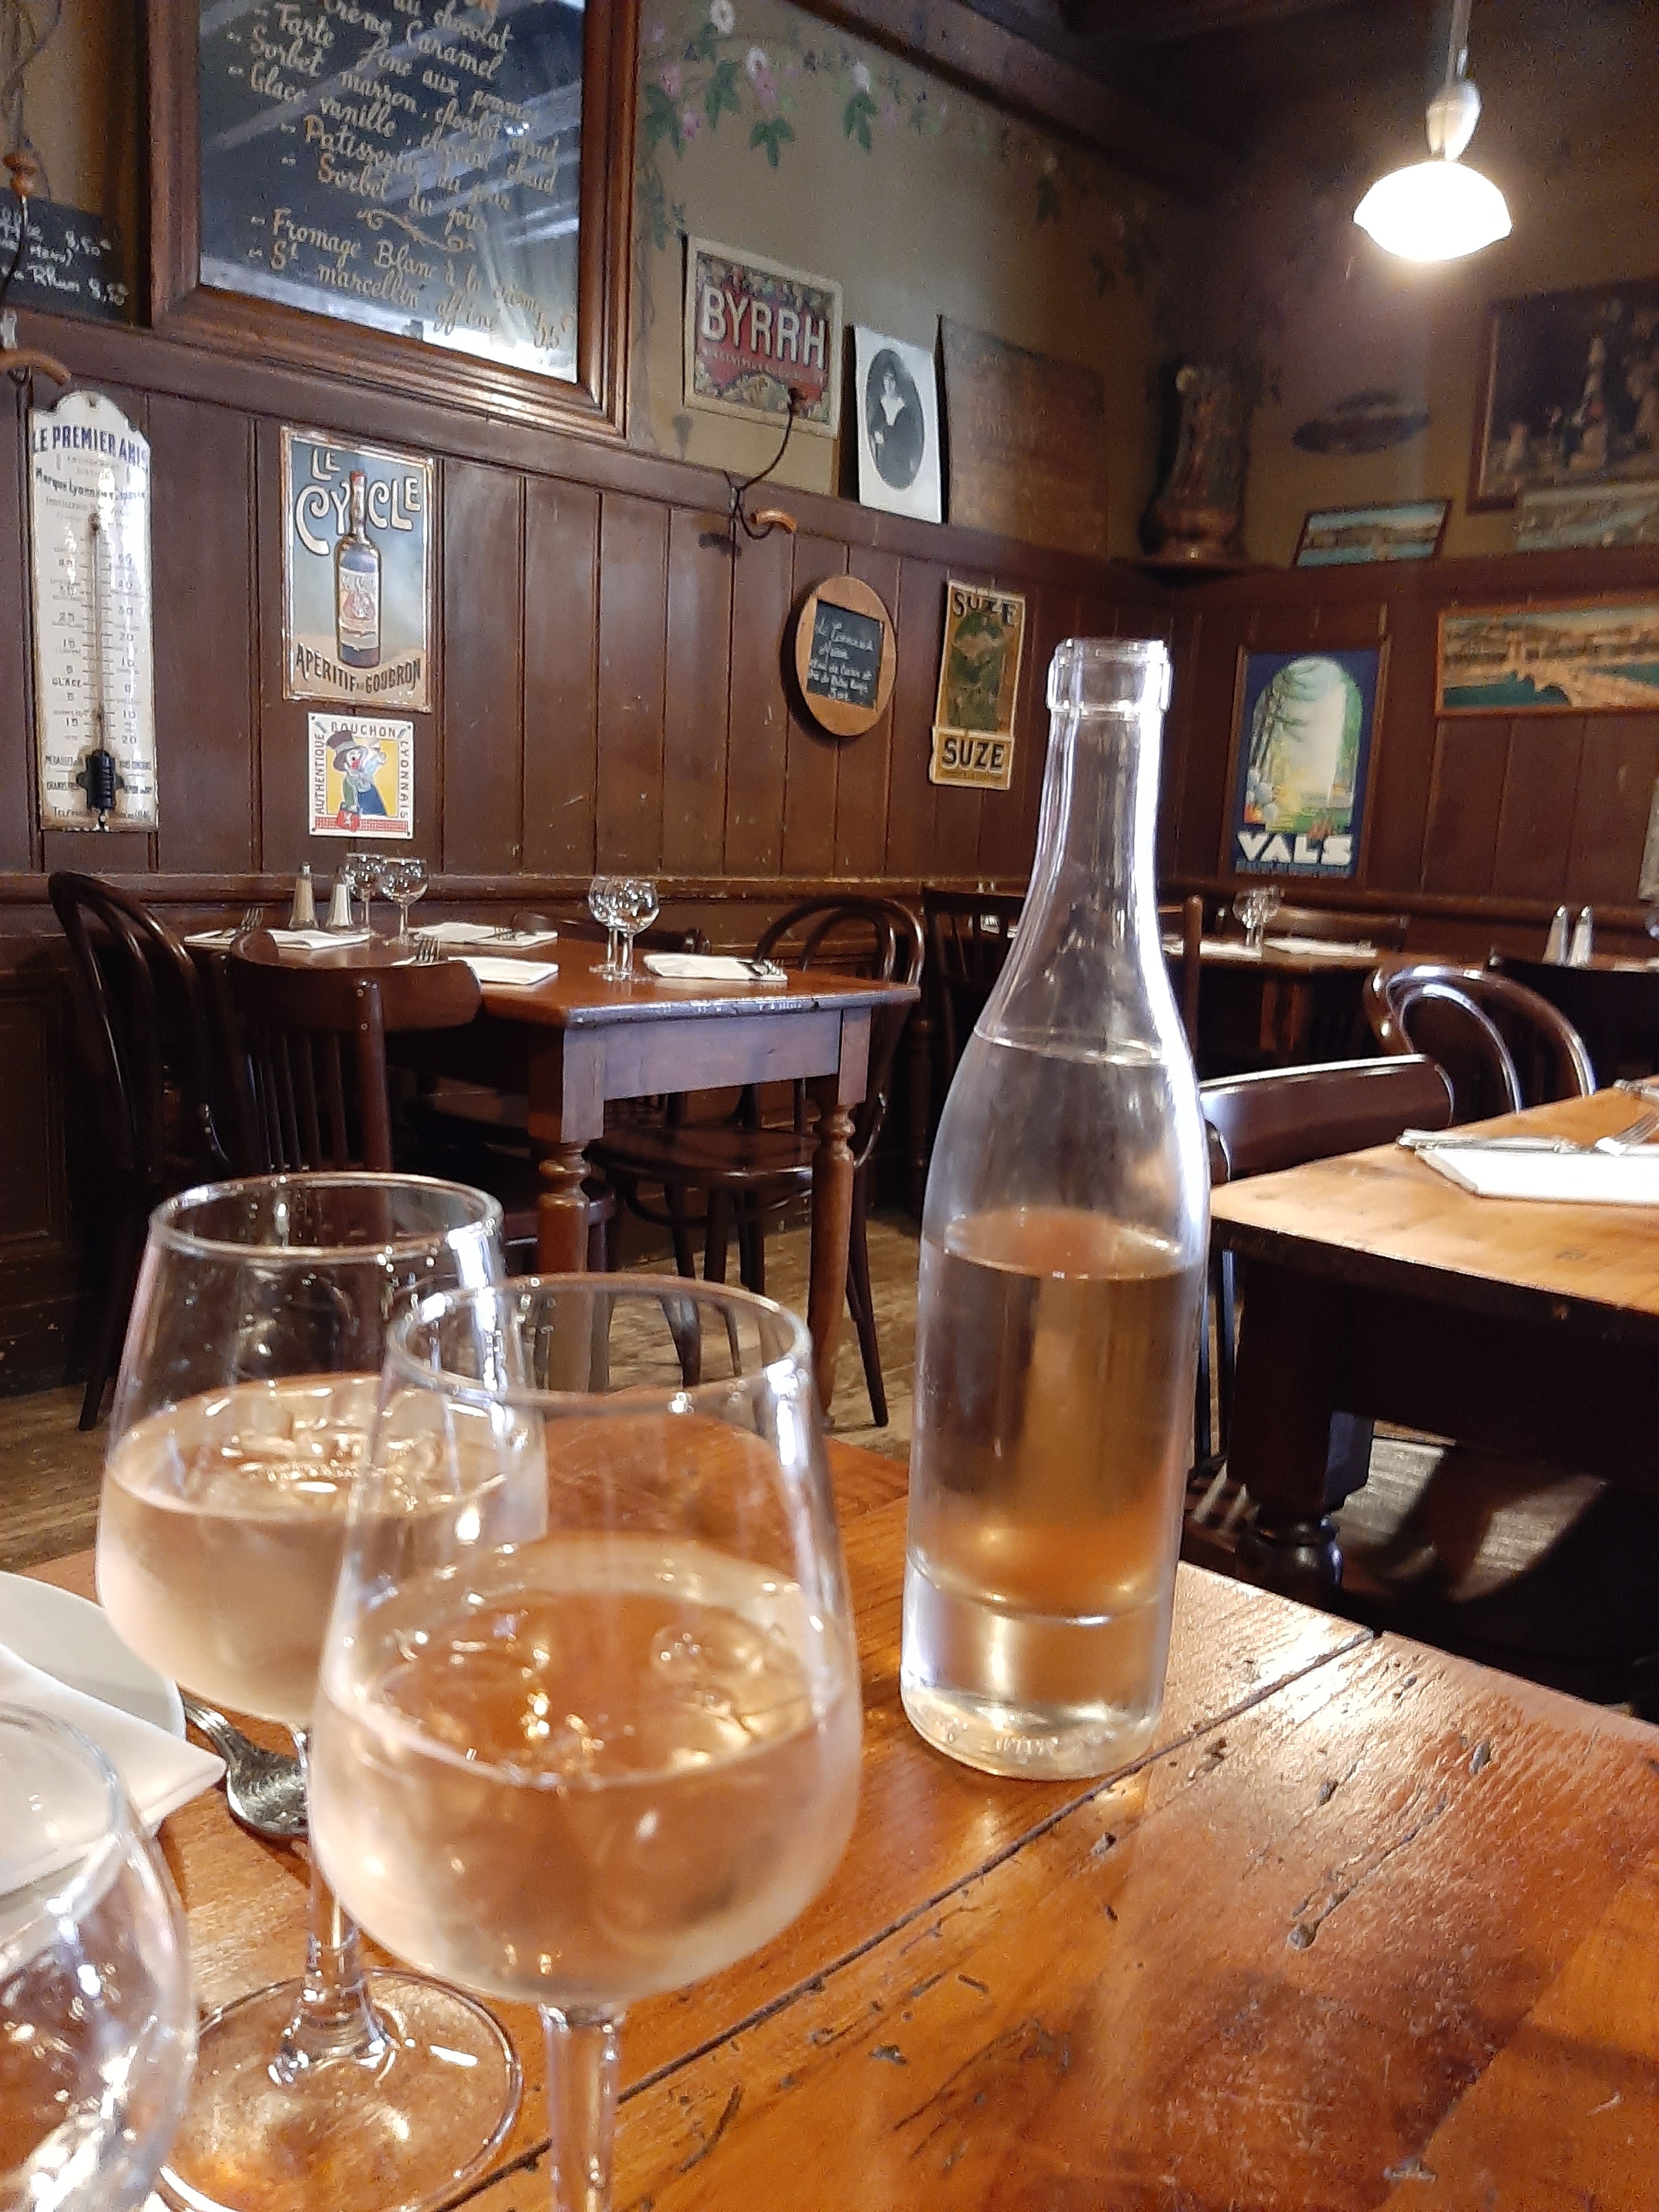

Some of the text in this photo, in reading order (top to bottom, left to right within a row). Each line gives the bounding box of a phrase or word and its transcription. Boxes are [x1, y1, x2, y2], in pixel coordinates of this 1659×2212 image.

[274, 3, 336, 49] Tarte
[249, 24, 325, 78] Sorbet
[250, 59, 311, 103] Glace
[317, 153, 386, 202] Sorbet
[272, 207, 361, 272] Fromage
[702, 284, 826, 372] BYRRH
[51, 425, 117, 456] PREMIER
[312, 447, 342, 481] LE
[296, 475, 422, 556] CYCLE
[314, 721, 410, 819] AUTHENTIQUE BOUCHON LYONNAIS
[941, 737, 1007, 771] SUZE
[1237, 828, 1354, 868] VALS
